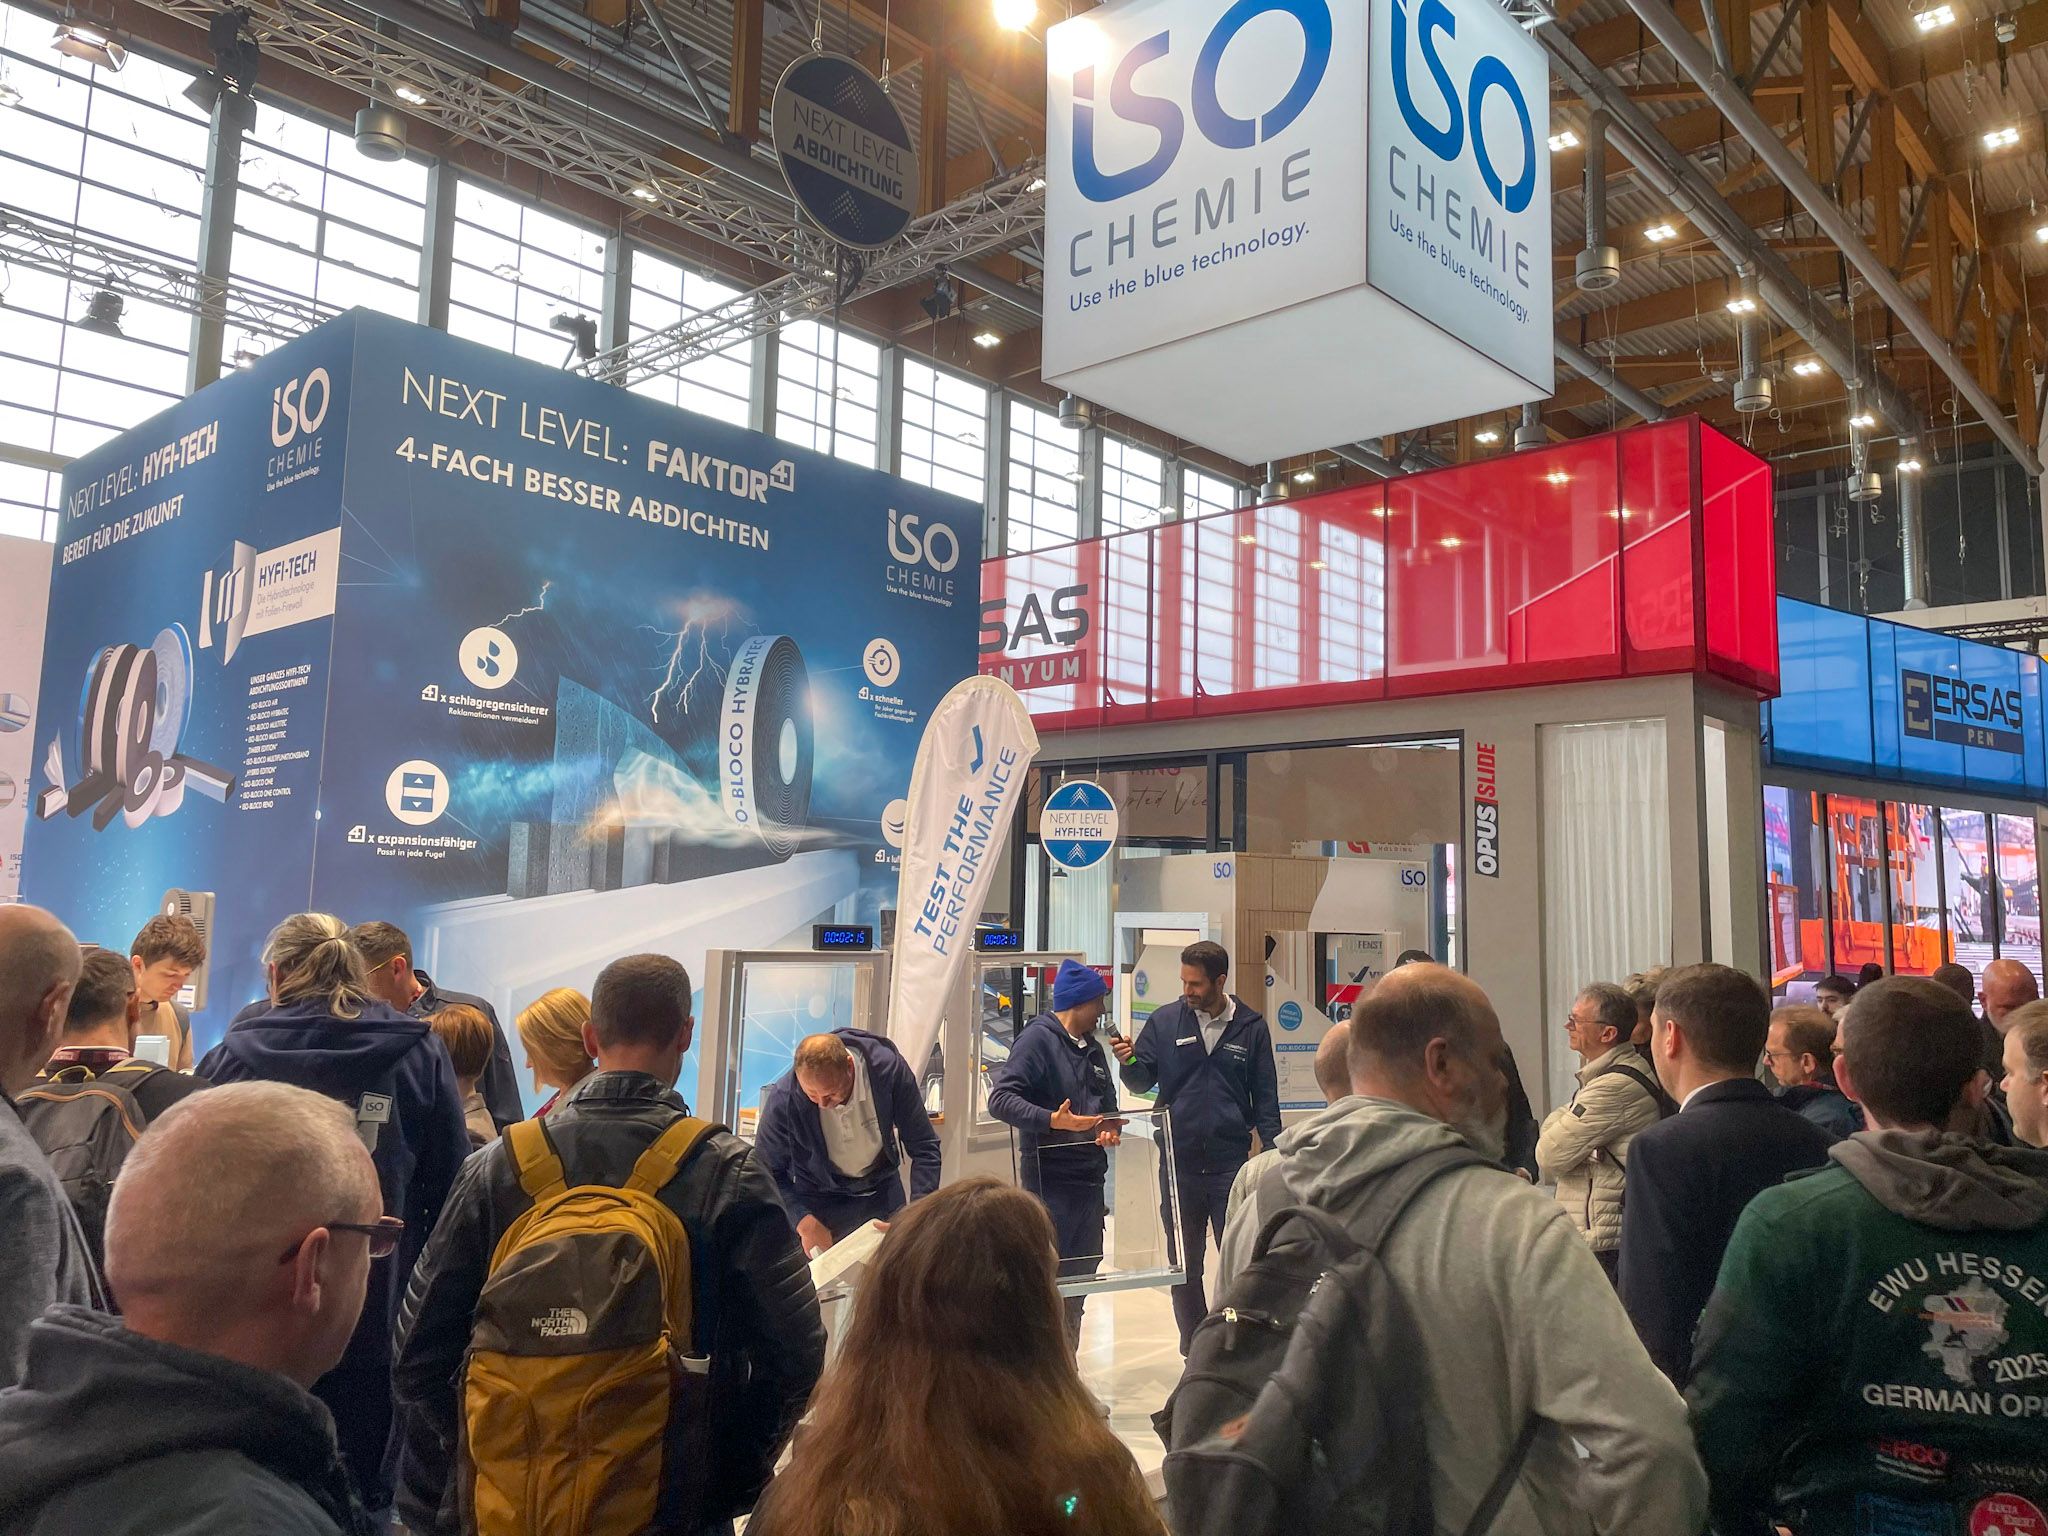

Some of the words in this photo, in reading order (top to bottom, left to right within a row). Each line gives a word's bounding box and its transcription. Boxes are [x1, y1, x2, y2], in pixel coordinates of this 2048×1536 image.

[793, 99, 846, 145] NEXT
[853, 126, 904, 175] LEVEL
[793, 134, 903, 199] ABDICHTUNG
[1070, 148, 1311, 278] CHEMIE
[1389, 145, 1530, 289] CHEMIE
[1069, 290, 1102, 312] Use
[1108, 278, 1137, 300] the
[1144, 261, 1185, 288] blue
[1192, 221, 1310, 272] technology.
[1389, 209, 1413, 243] Use
[1417, 230, 1437, 259] the
[1441, 248, 1466, 280] blue
[1470, 270, 1530, 324] technology.
[401, 365, 507, 430] NEXT
[520, 401, 629, 465] LEVEL:
[67, 481, 98, 522] NEXT
[99, 464, 138, 507] LEVEL:
[142, 420, 219, 486] HYFI-TECH
[267, 437, 322, 478] CHEMIE
[266, 483, 276, 492] Use
[283, 475, 294, 485] blue
[395, 436, 514, 488] 4-FACH
[524, 467, 621, 515] BESSER
[627, 496, 770, 552] ABDICHTEN
[62, 535, 91, 565] BEREIT
[92, 523, 112, 553] FÜR
[113, 521, 130, 543] DIE
[131, 493, 184, 536] ZUKUNFT
[259, 550, 317, 589] HYFI-TECH
[886, 565, 954, 596] CHEMIE
[886, 584, 898, 593] Use
[898, 587, 908, 596] the
[909, 590, 922, 600] blue
[250, 674, 266, 685] UNSER
[266, 669, 285, 682] GANZES
[731, 639, 767, 714] HYBRATEC
[440, 694, 447, 703] x
[448, 694, 549, 716] schlagregensicherer
[448, 706, 500, 721] Reklamationen
[501, 714, 540, 725] vermeiden!
[874, 694, 904, 706] schneller
[1967, 728, 1995, 747] PEN
[1476, 741, 1496, 798] SLIDE
[1050, 812, 1077, 825] NEXT
[1080, 812, 1109, 825] LEVEL
[1054, 827, 1102, 837] HYFI-TECH
[368, 834, 375, 843] x
[377, 835, 477, 851] expansionsfähiger
[377, 847, 396, 856] Passt
[398, 847, 405, 857] in
[406, 848, 423, 859] jede
[425, 850, 446, 860] Fuge!
[932, 746, 1017, 957] PERFORMANCE
[1476, 804, 1498, 876] OPUS
[914, 863, 952, 938] TEST
[943, 793, 974, 855] THE
[1867, 1257, 1929, 1313] EWU
[531, 1317, 570, 1328] NORTH
[540, 1327, 569, 1337] FACE
[550, 1307, 572, 1318] THE
[1987, 1352, 2048, 1384] 2025
[1862, 1383, 1992, 1416] GERMAN
